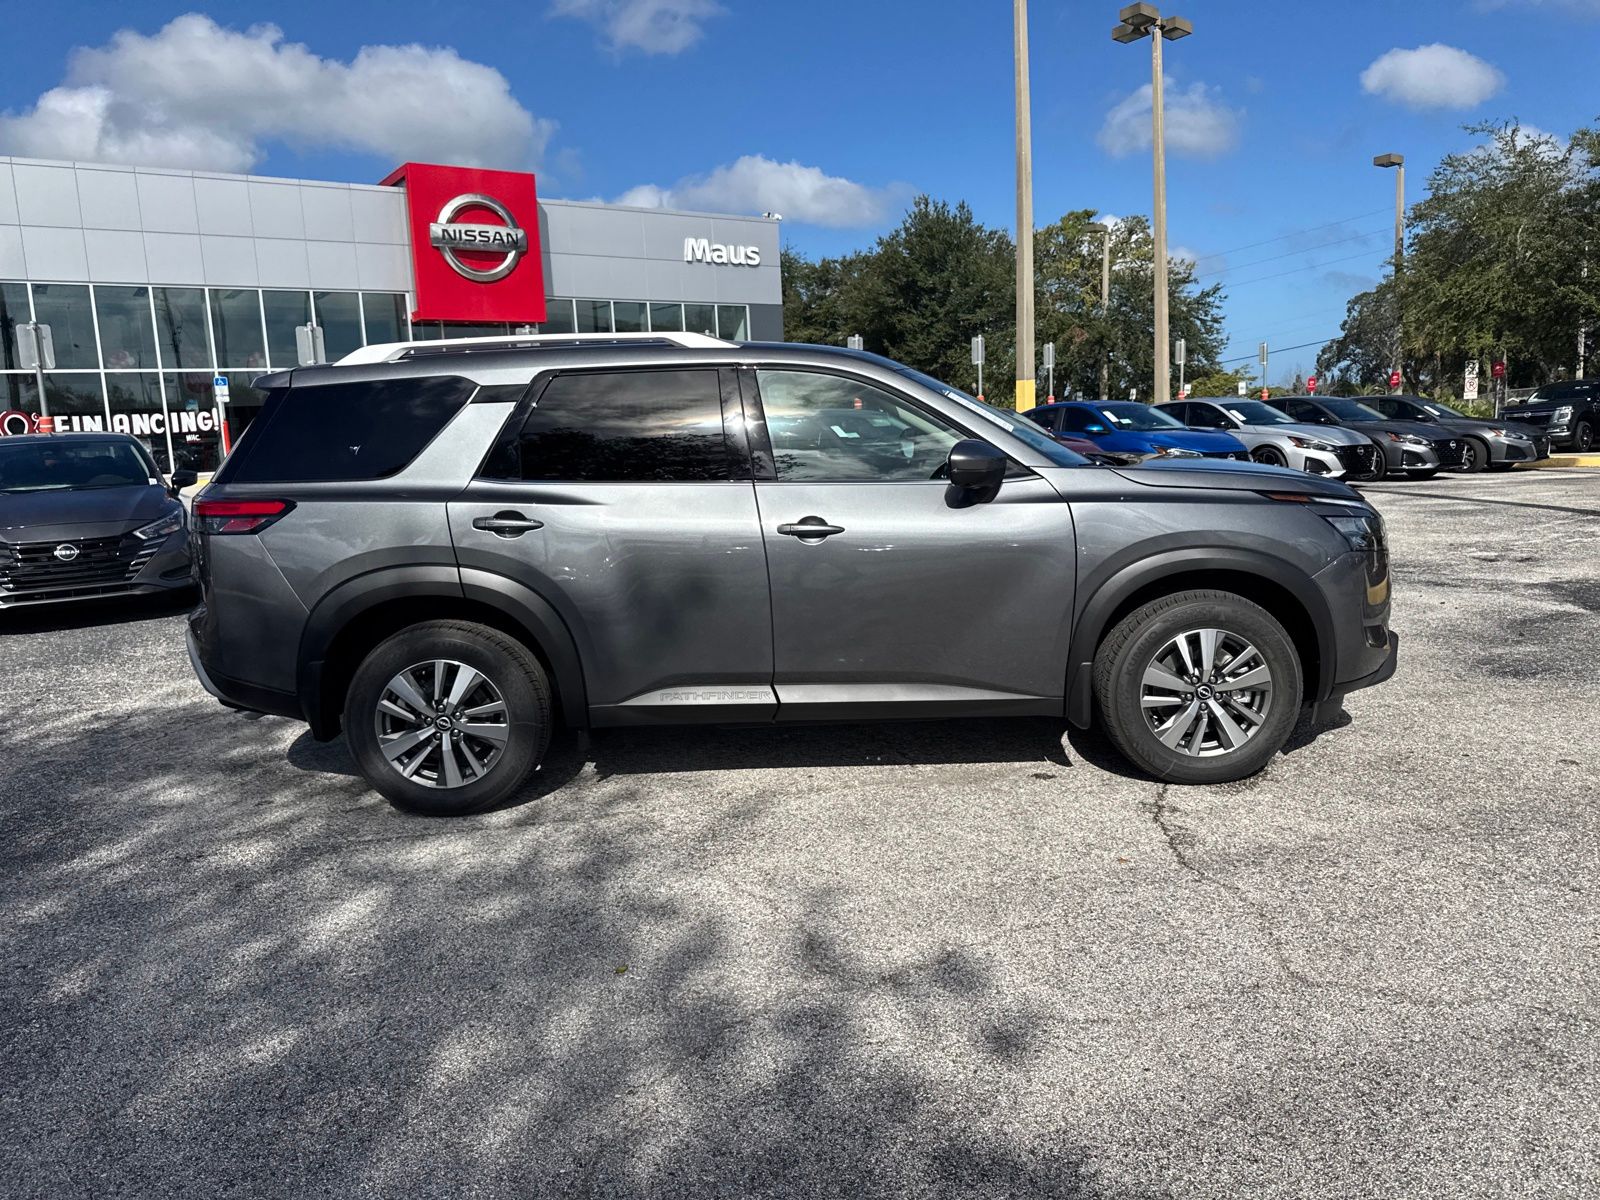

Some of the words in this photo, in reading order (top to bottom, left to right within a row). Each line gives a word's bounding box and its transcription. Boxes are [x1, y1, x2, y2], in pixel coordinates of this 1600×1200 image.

[442, 228, 520, 246] NISSAN
[683, 237, 761, 266] Maus
[53, 407, 219, 433] FINANCING!
[659, 690, 772, 702] PATHFINDER
